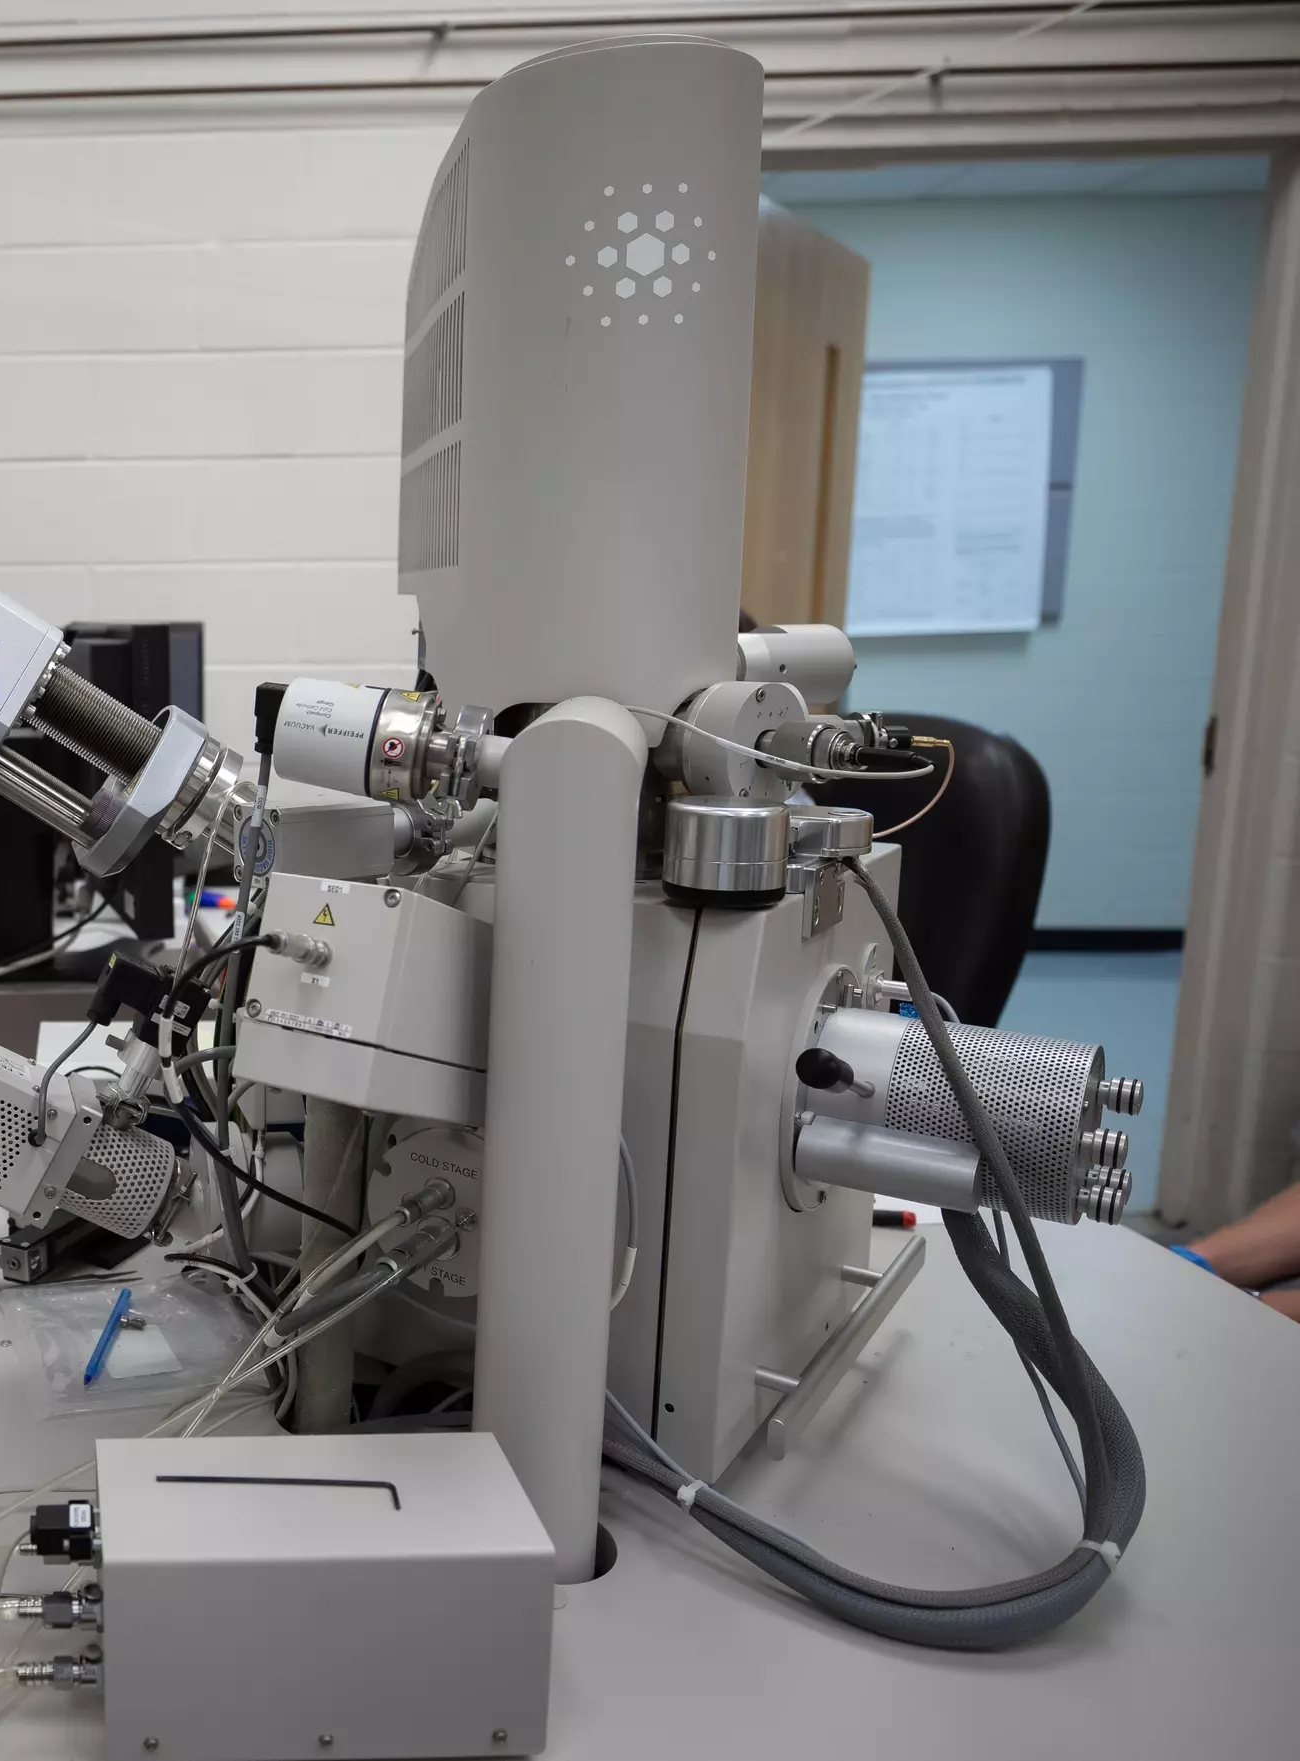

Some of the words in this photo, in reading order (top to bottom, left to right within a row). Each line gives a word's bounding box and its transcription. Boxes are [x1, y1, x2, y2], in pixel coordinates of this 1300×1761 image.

[283, 720, 315, 731] VACUUM
[327, 727, 365, 739] PFEIFFER
[410, 1152, 440, 1168] COLD
[442, 1161, 478, 1180] STAGE
[430, 1266, 466, 1287] STAGE
